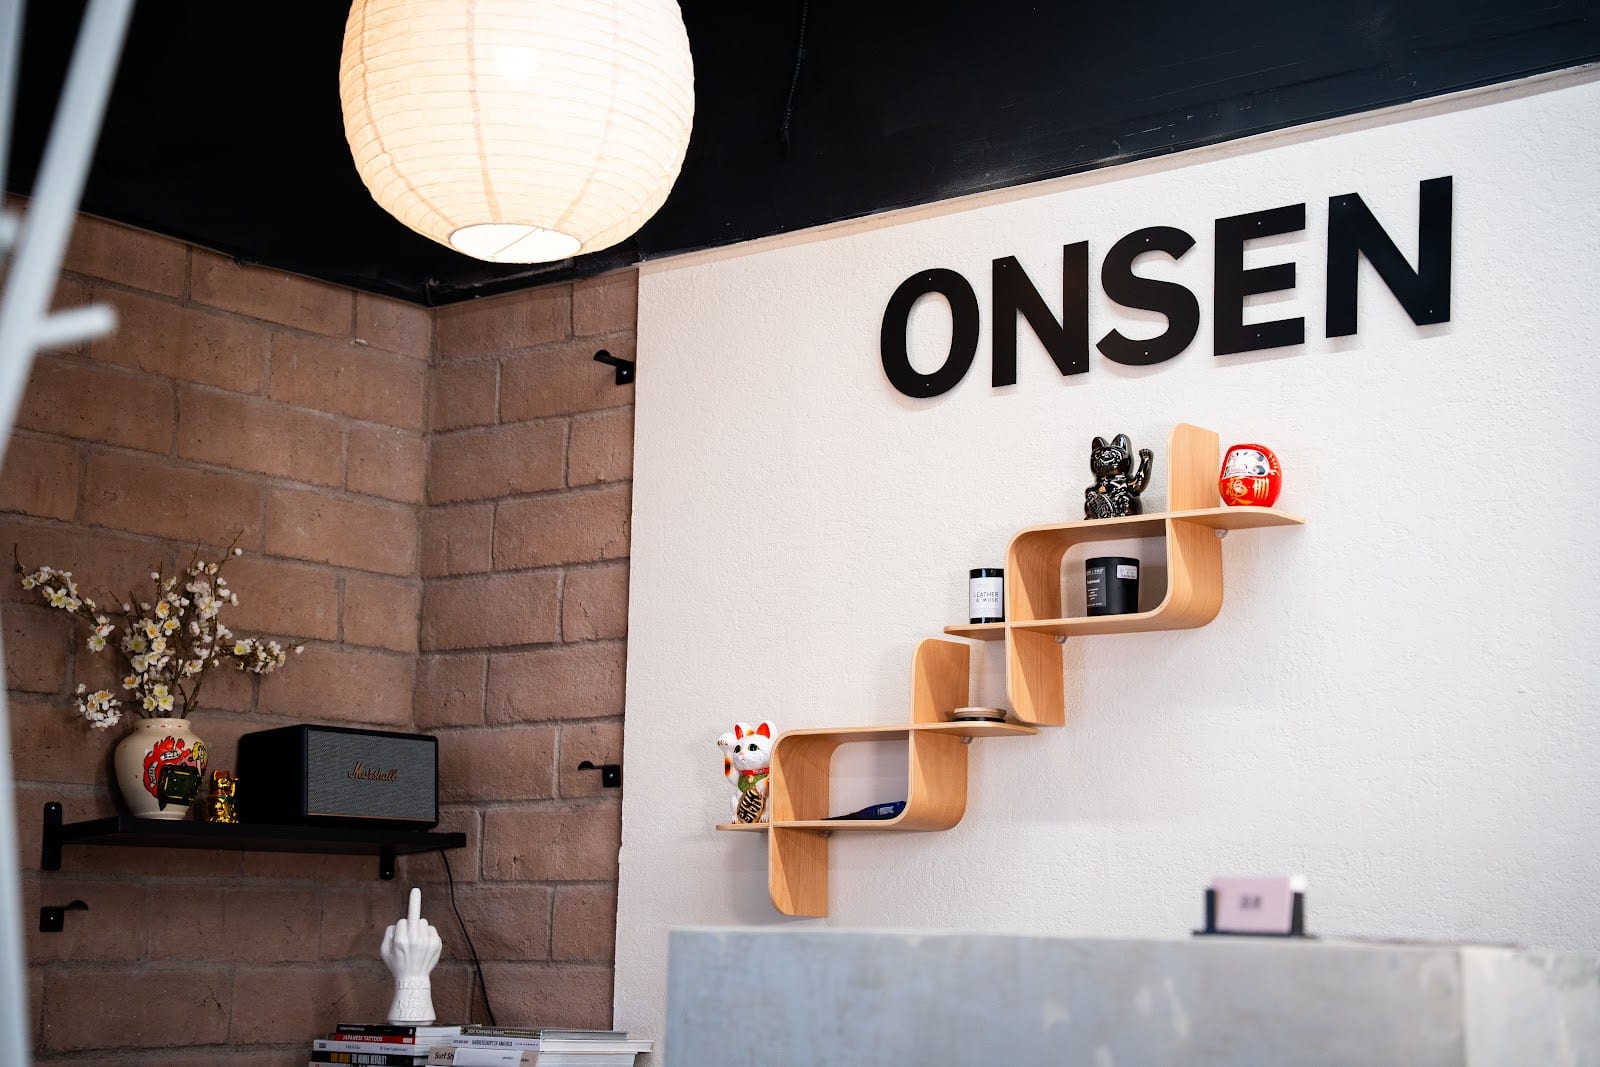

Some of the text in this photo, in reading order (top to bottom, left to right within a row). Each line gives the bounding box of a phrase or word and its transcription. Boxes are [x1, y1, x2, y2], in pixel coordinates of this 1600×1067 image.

[880, 175, 1453, 399] ONSEN
[347, 760, 398, 782] Marshall
[434, 1051, 446, 1060] Surf
